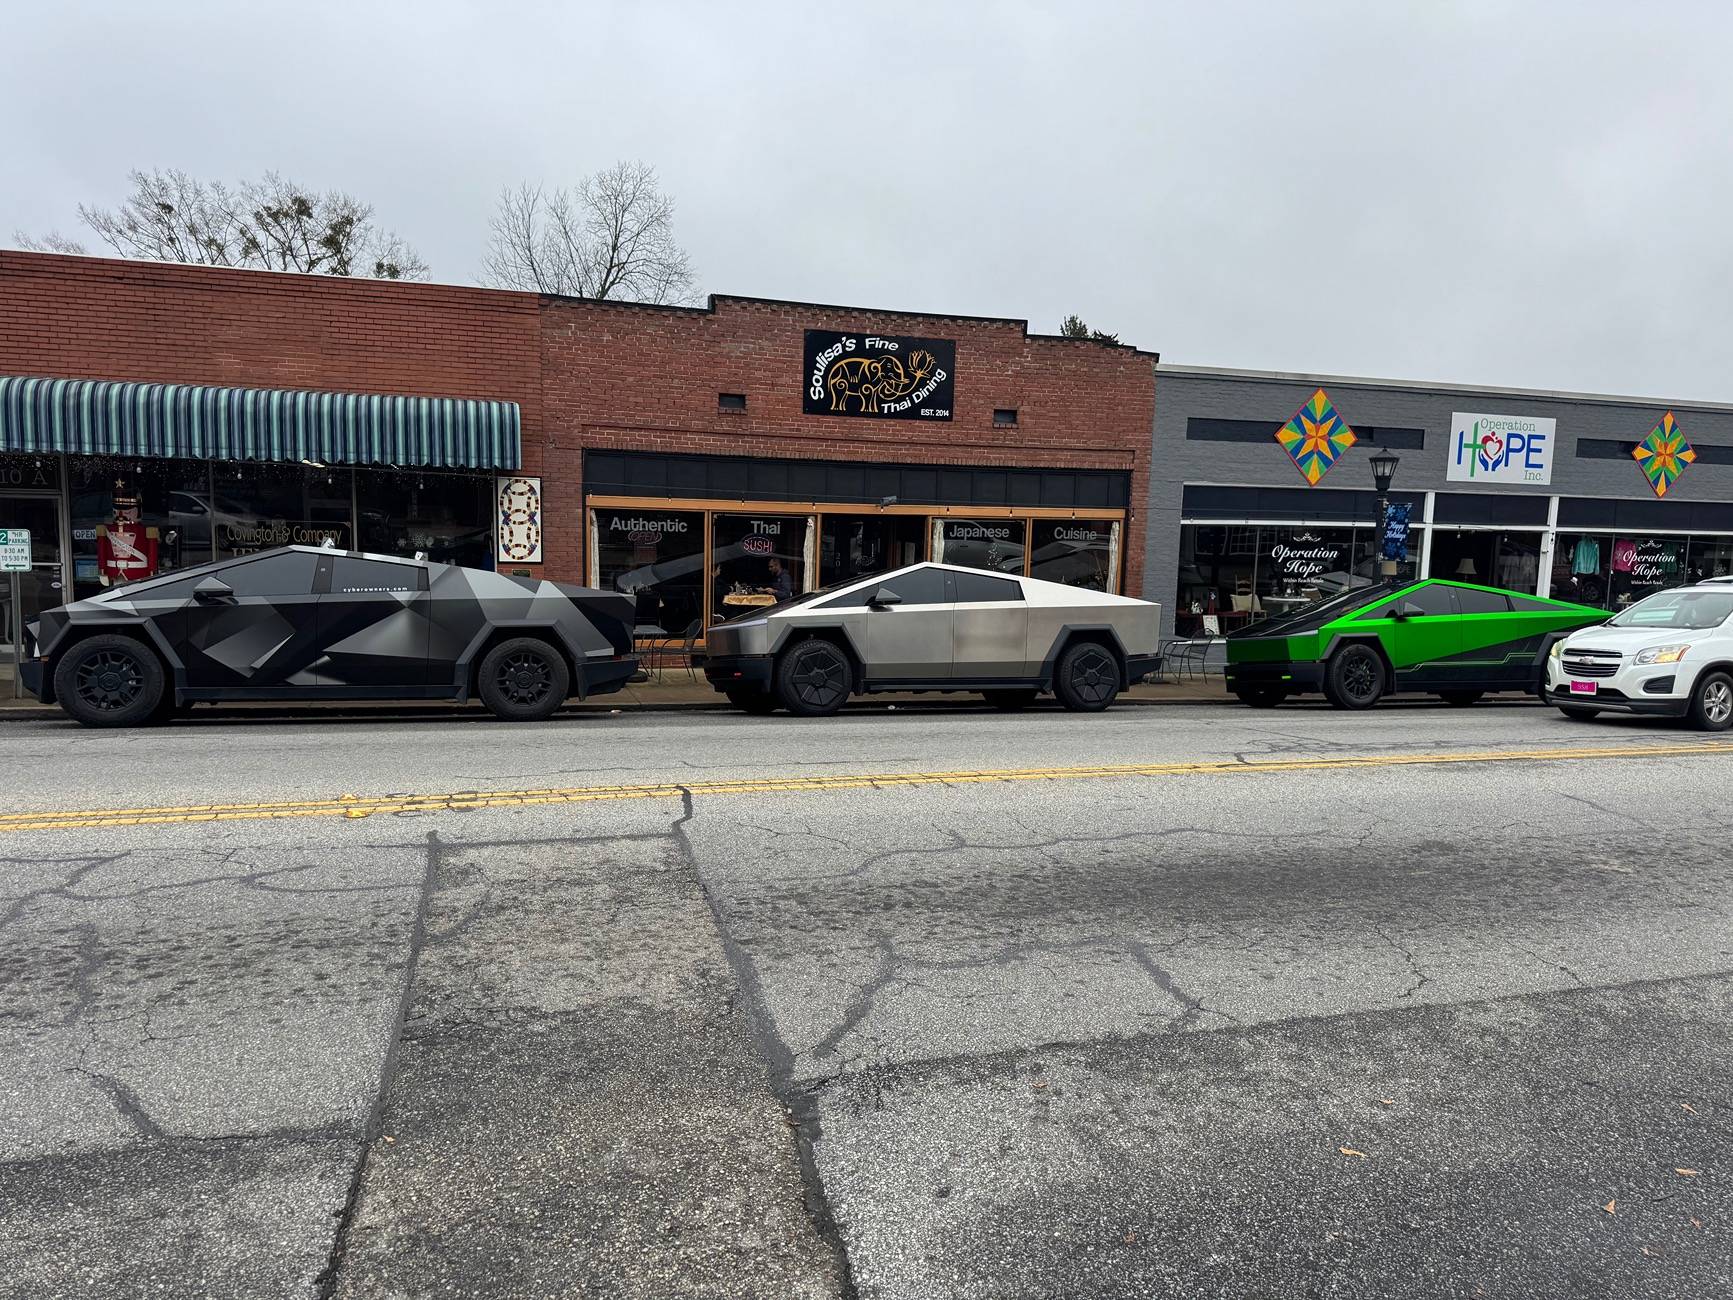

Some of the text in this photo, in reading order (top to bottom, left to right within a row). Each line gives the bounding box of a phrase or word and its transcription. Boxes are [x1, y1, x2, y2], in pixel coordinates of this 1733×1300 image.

[810, 336, 898, 400] Soulisa's Fine
[881, 368, 946, 414] Thai Dining
[920, 408, 934, 416] EST.
[1481, 418, 1536, 432] Operation
[1524, 470, 1544, 480] Inc.
[610, 516, 688, 532] Authentic
[751, 520, 780, 534] Thai
[950, 524, 1010, 540] Japanese
[0, 532, 6, 544] 2
[226, 525, 279, 544] Covington
[293, 526, 342, 543] Company
[1054, 526, 1097, 540] Cuisine
[744, 538, 773, 552] SUSHI
[1272, 544, 1338, 562] Operation
[1623, 550, 1676, 566] Operation
[1284, 560, 1323, 578] Hope
[1632, 564, 1662, 580] Hope
